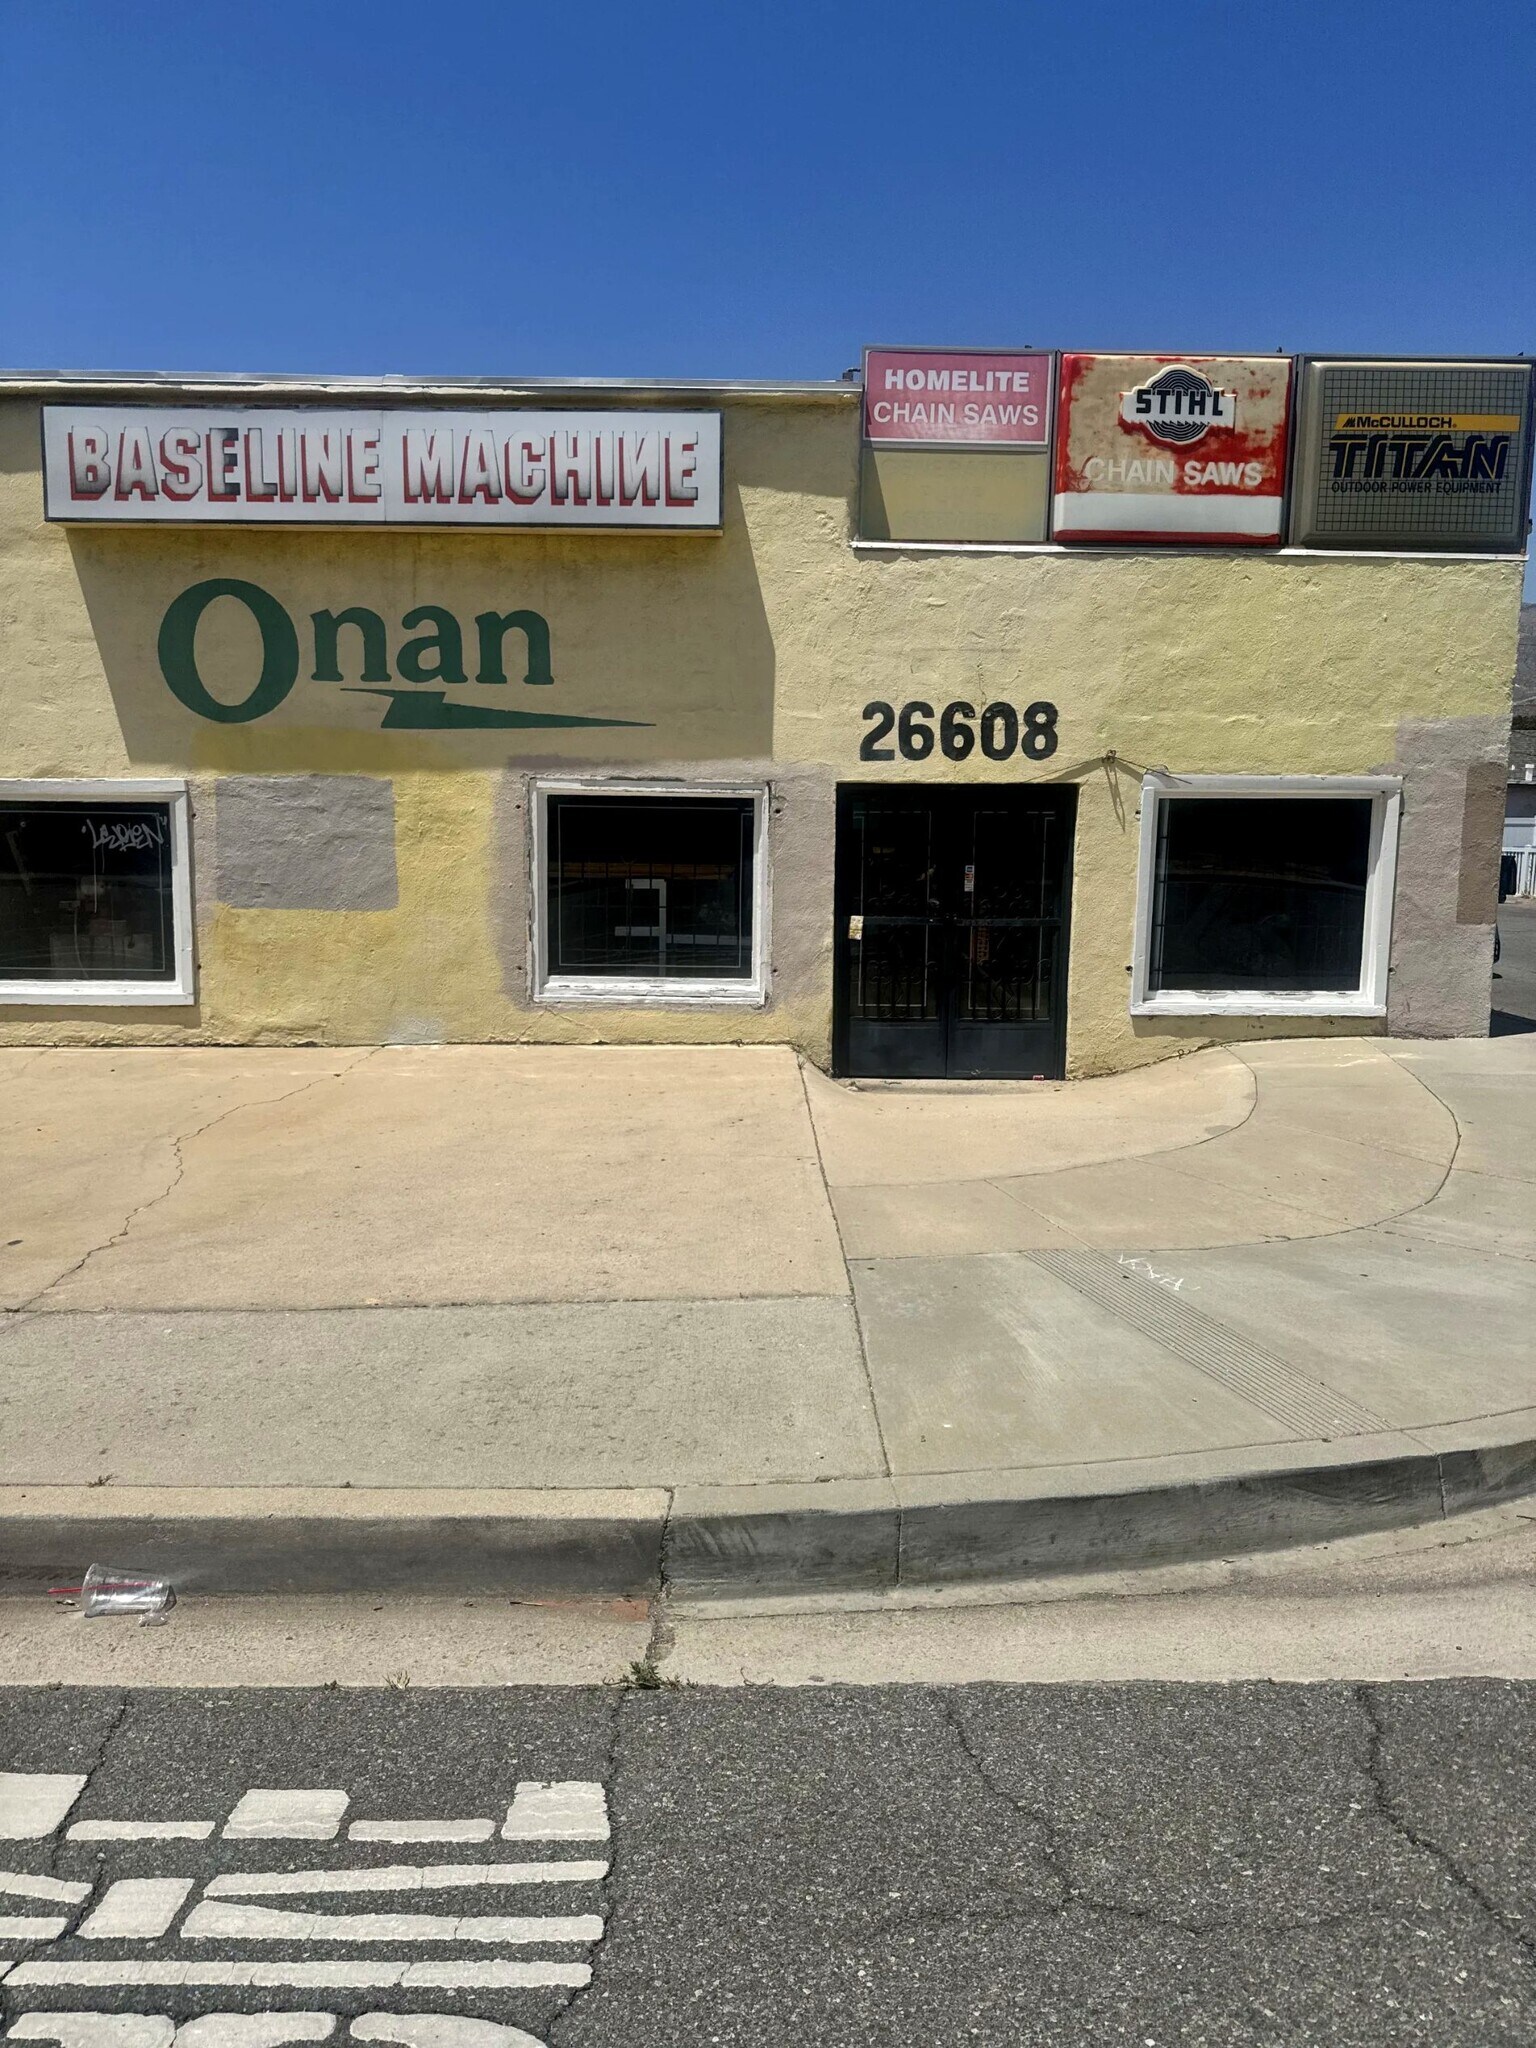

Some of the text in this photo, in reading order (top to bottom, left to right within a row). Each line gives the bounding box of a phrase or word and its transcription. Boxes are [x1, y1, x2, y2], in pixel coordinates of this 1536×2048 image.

[884, 368, 1030, 393] HOMELITE
[873, 401, 1039, 426] CHAIN SAWS
[1135, 388, 1224, 417] STIHL
[67, 424, 699, 507] BASELINE MACHINE
[1084, 457, 1263, 487] CHAIN SAWS
[1328, 434, 1511, 480] TITAN
[1331, 481, 1502, 496] OUTDOOR POWER EQUIPMENT
[158, 578, 554, 724] Onan
[859, 700, 1059, 762] 26608
